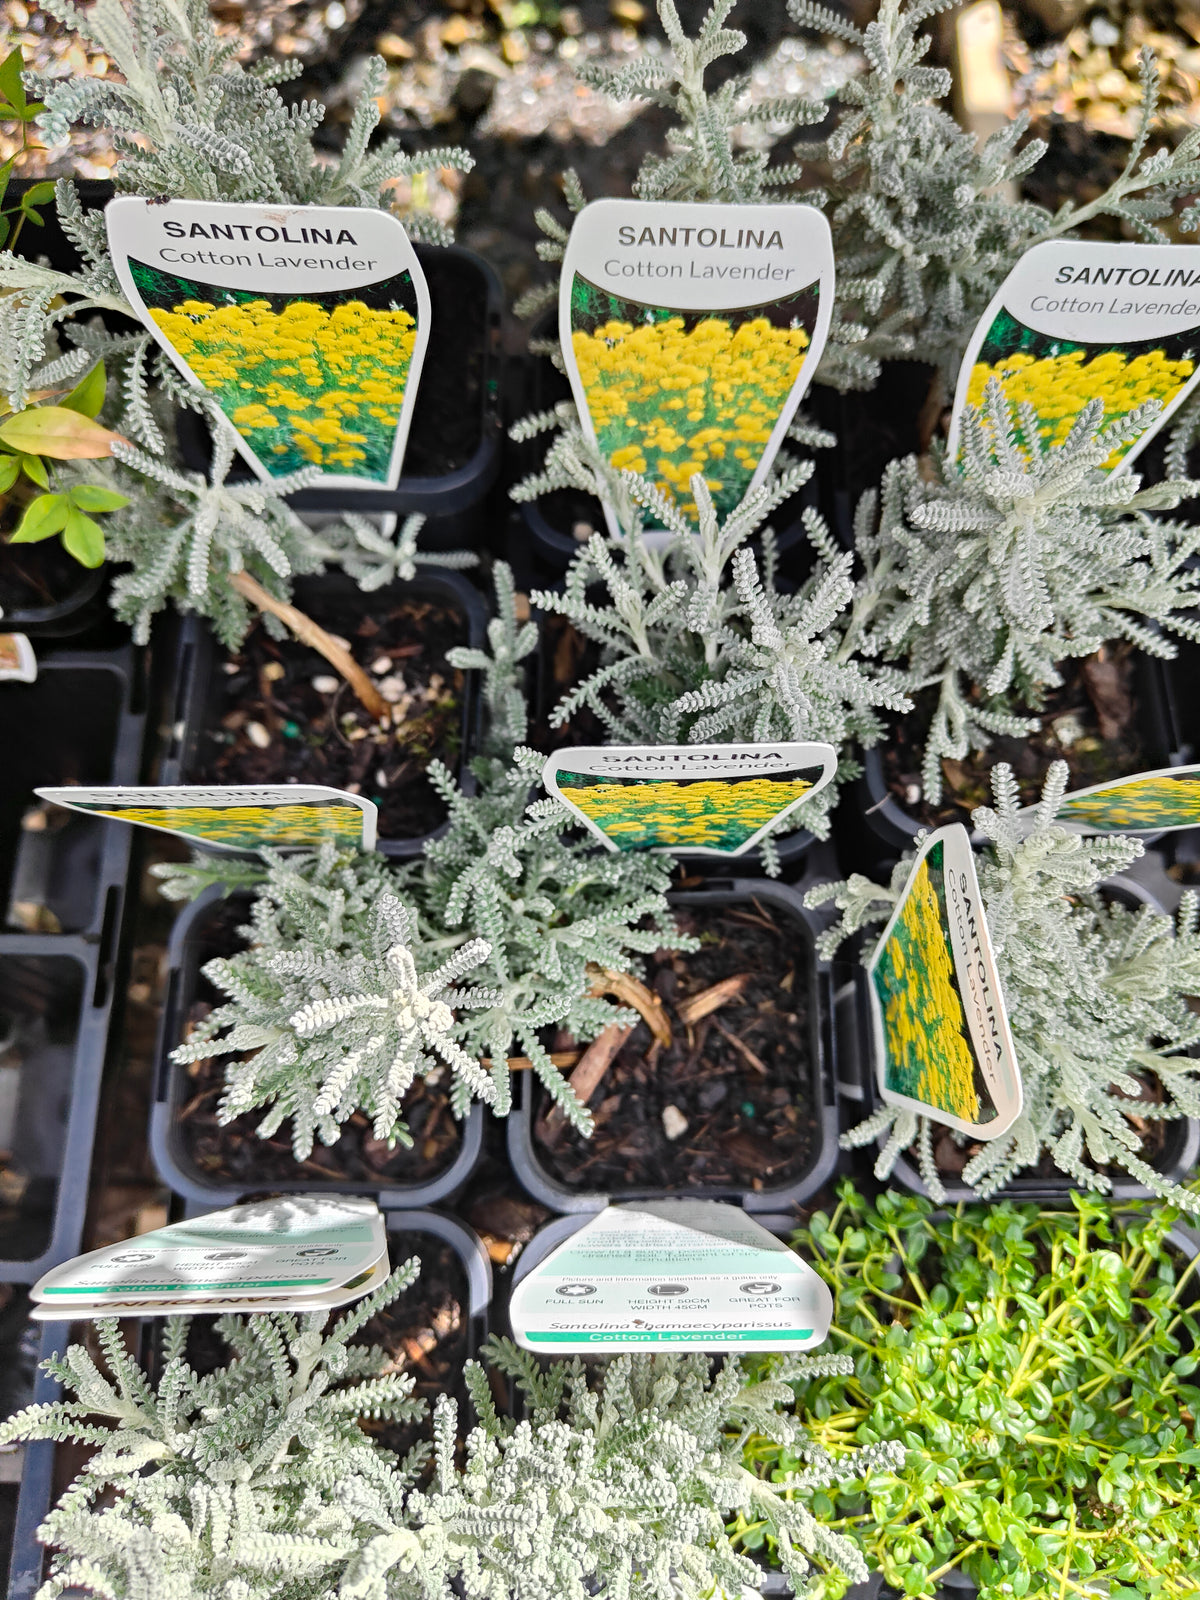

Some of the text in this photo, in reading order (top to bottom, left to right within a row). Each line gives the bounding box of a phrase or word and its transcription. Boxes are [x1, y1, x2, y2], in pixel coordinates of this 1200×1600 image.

[162, 221, 358, 246] SANTOLINA
[618, 226, 785, 250] SANTOLINA
[159, 248, 379, 271] Cotton Lavender
[604, 259, 796, 281] Cotton Lavender
[1030, 295, 1104, 314] Cotton
[603, 752, 783, 763] SANTOLINA
[682, 762, 796, 771] Lavender
[949, 868, 996, 1084] Cotton Lavender
[960, 872, 1002, 1062] SANTOLINA
[174, 1282, 265, 1291] Lavender
[549, 1320, 793, 1331] Santolina chamaecyparissus
[589, 1332, 747, 1341] Cotton Lavender
